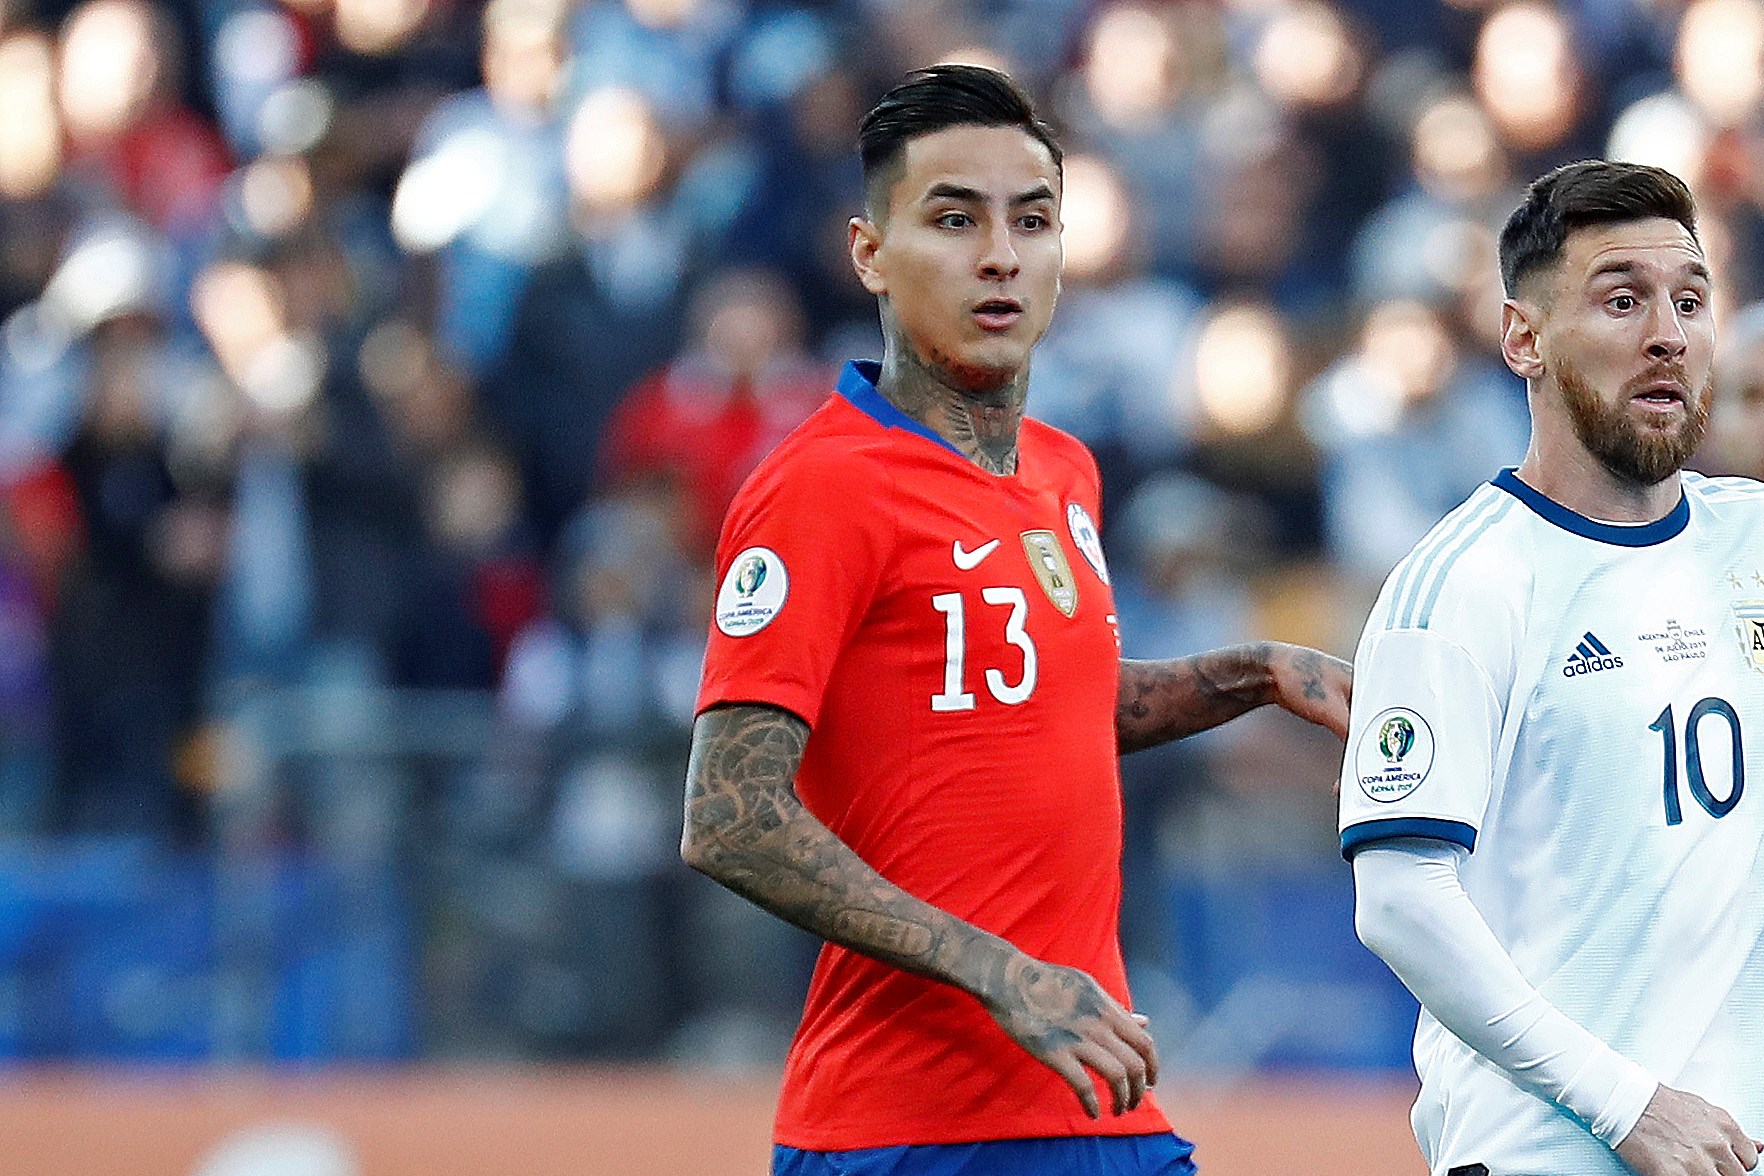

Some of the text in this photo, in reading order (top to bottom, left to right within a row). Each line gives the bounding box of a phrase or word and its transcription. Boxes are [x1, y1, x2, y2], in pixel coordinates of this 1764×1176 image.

[931, 587, 1038, 712] 13
[1563, 656, 1624, 678] adidas
[1648, 697, 1745, 827] 10
